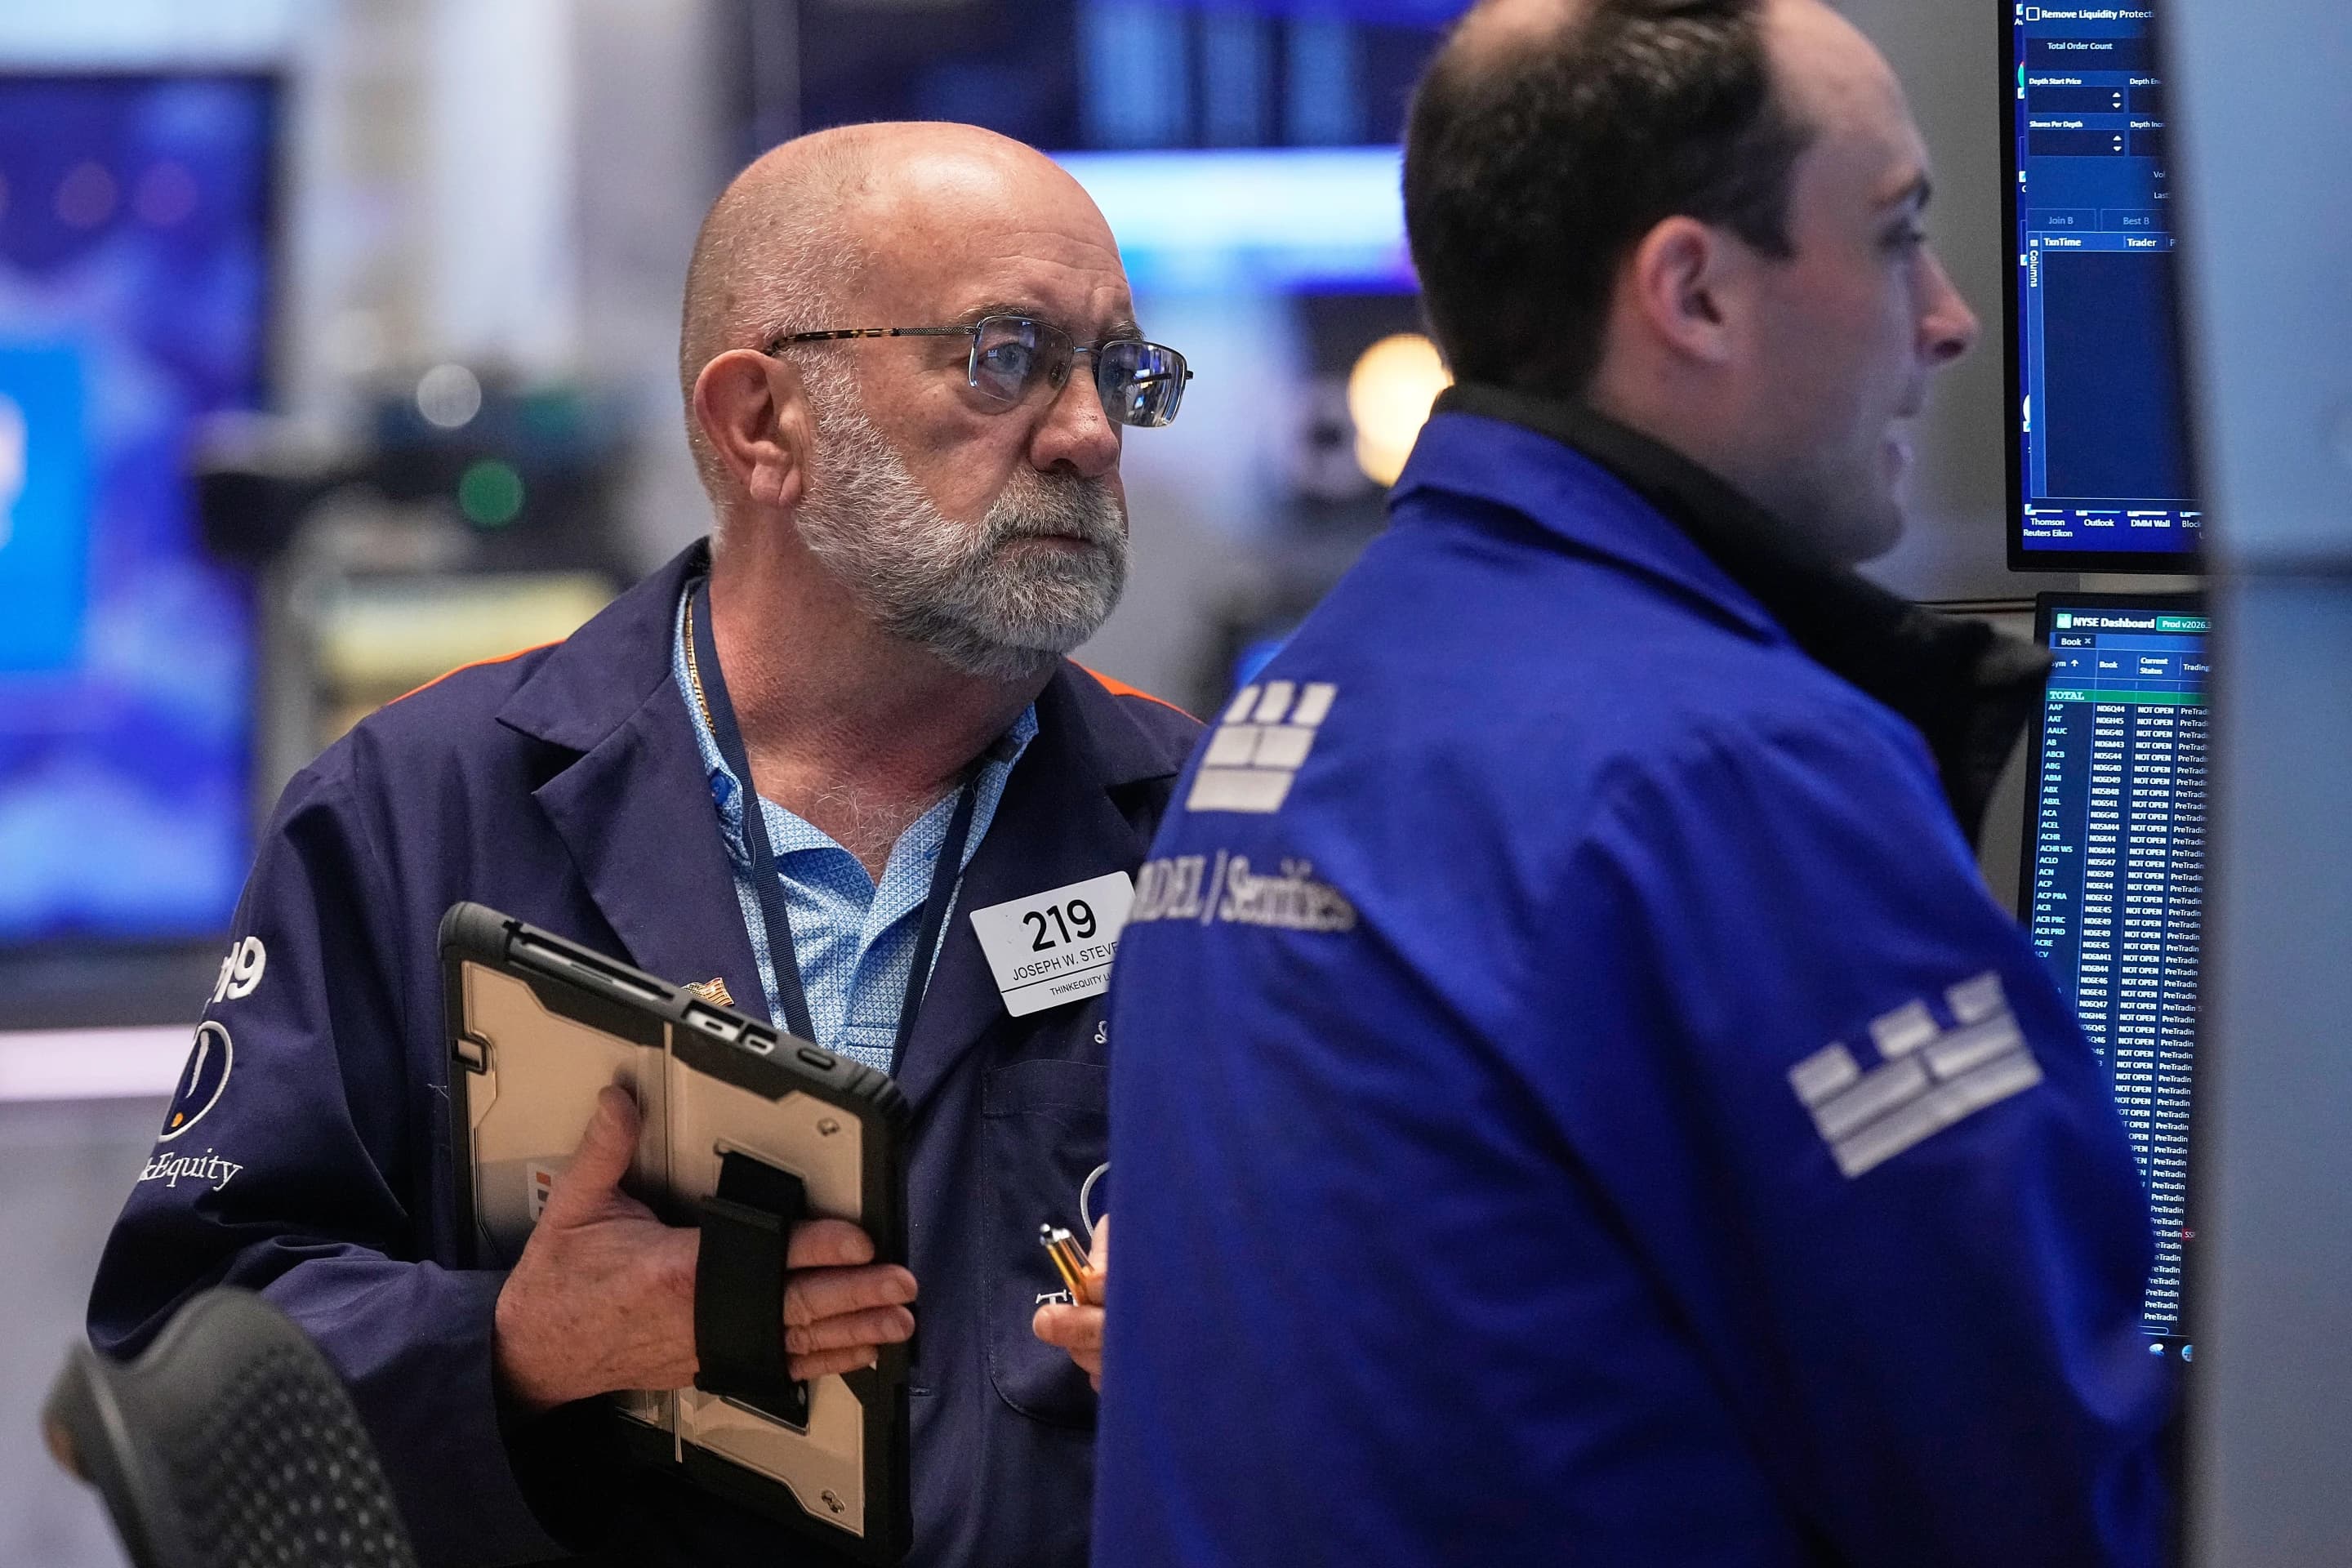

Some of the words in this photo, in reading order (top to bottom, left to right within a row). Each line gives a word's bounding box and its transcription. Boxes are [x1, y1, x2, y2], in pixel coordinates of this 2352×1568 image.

[2042, 10, 2077, 18] Remove
[2079, 10, 2118, 20] Liquidity
[2043, 238, 2081, 246] TxnTime
[2030, 250, 2038, 287] Columns
[2073, 617, 2099, 626] NYSE
[2100, 618, 2154, 628] Dashboard
[2050, 691, 2084, 700] TOTAL
[1022, 899, 1096, 952] 219
[211, 937, 266, 1004] 19
[1013, 957, 1062, 980] JOSEPH
[1062, 953, 1079, 966] W.
[1050, 975, 1102, 996] THINKEQUITY
